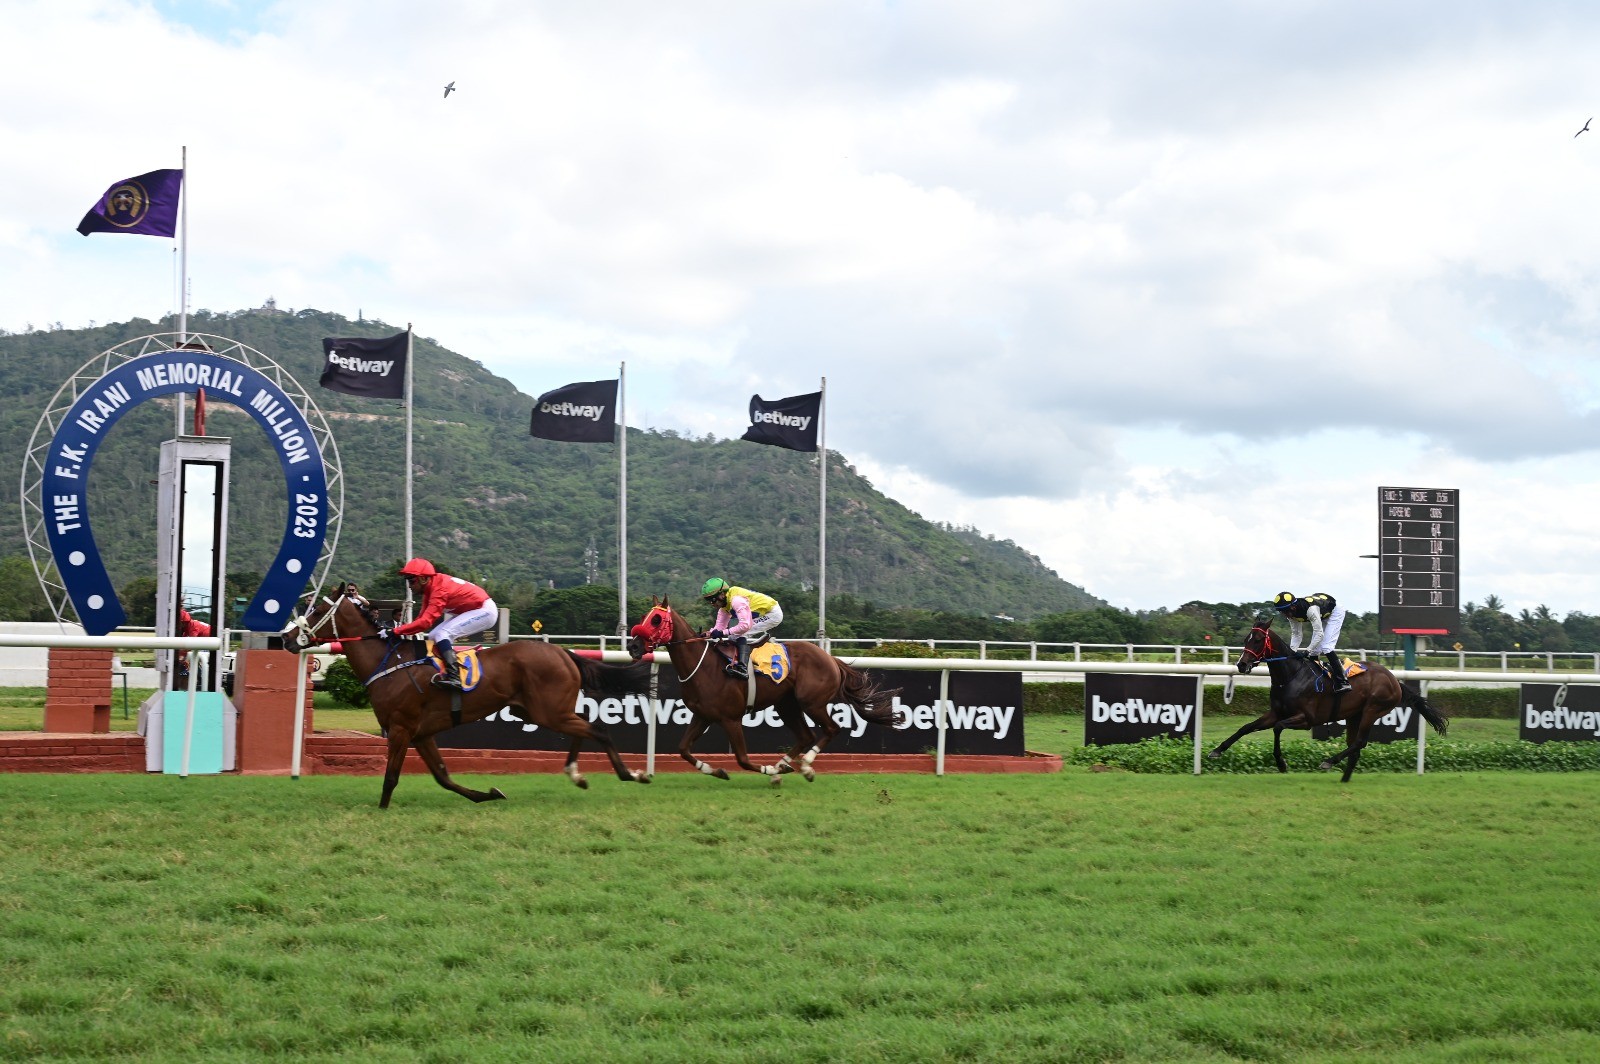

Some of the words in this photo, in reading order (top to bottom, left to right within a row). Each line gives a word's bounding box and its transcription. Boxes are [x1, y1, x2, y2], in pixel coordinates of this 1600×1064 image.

[328, 350, 395, 377] betway
[135, 362, 244, 398] MEMORIAL
[75, 381, 131, 435] IRANI
[540, 401, 605, 422] betway
[753, 410, 812, 431] betway
[250, 388, 310, 464] MILLION
[54, 442, 89, 479] F.K.
[53, 494, 82, 535] THE
[293, 493, 319, 539] 2023
[1397, 521, 1403, 536] 2
[1397, 539, 1403, 554] 1
[1397, 556, 1403, 571] 4
[1397, 573, 1403, 588] 5
[1397, 590, 1403, 605] 3
[771, 655, 783, 680] 5
[575, 689, 694, 725] betwa
[892, 696, 1016, 740] betway
[1091, 694, 1194, 733] betway
